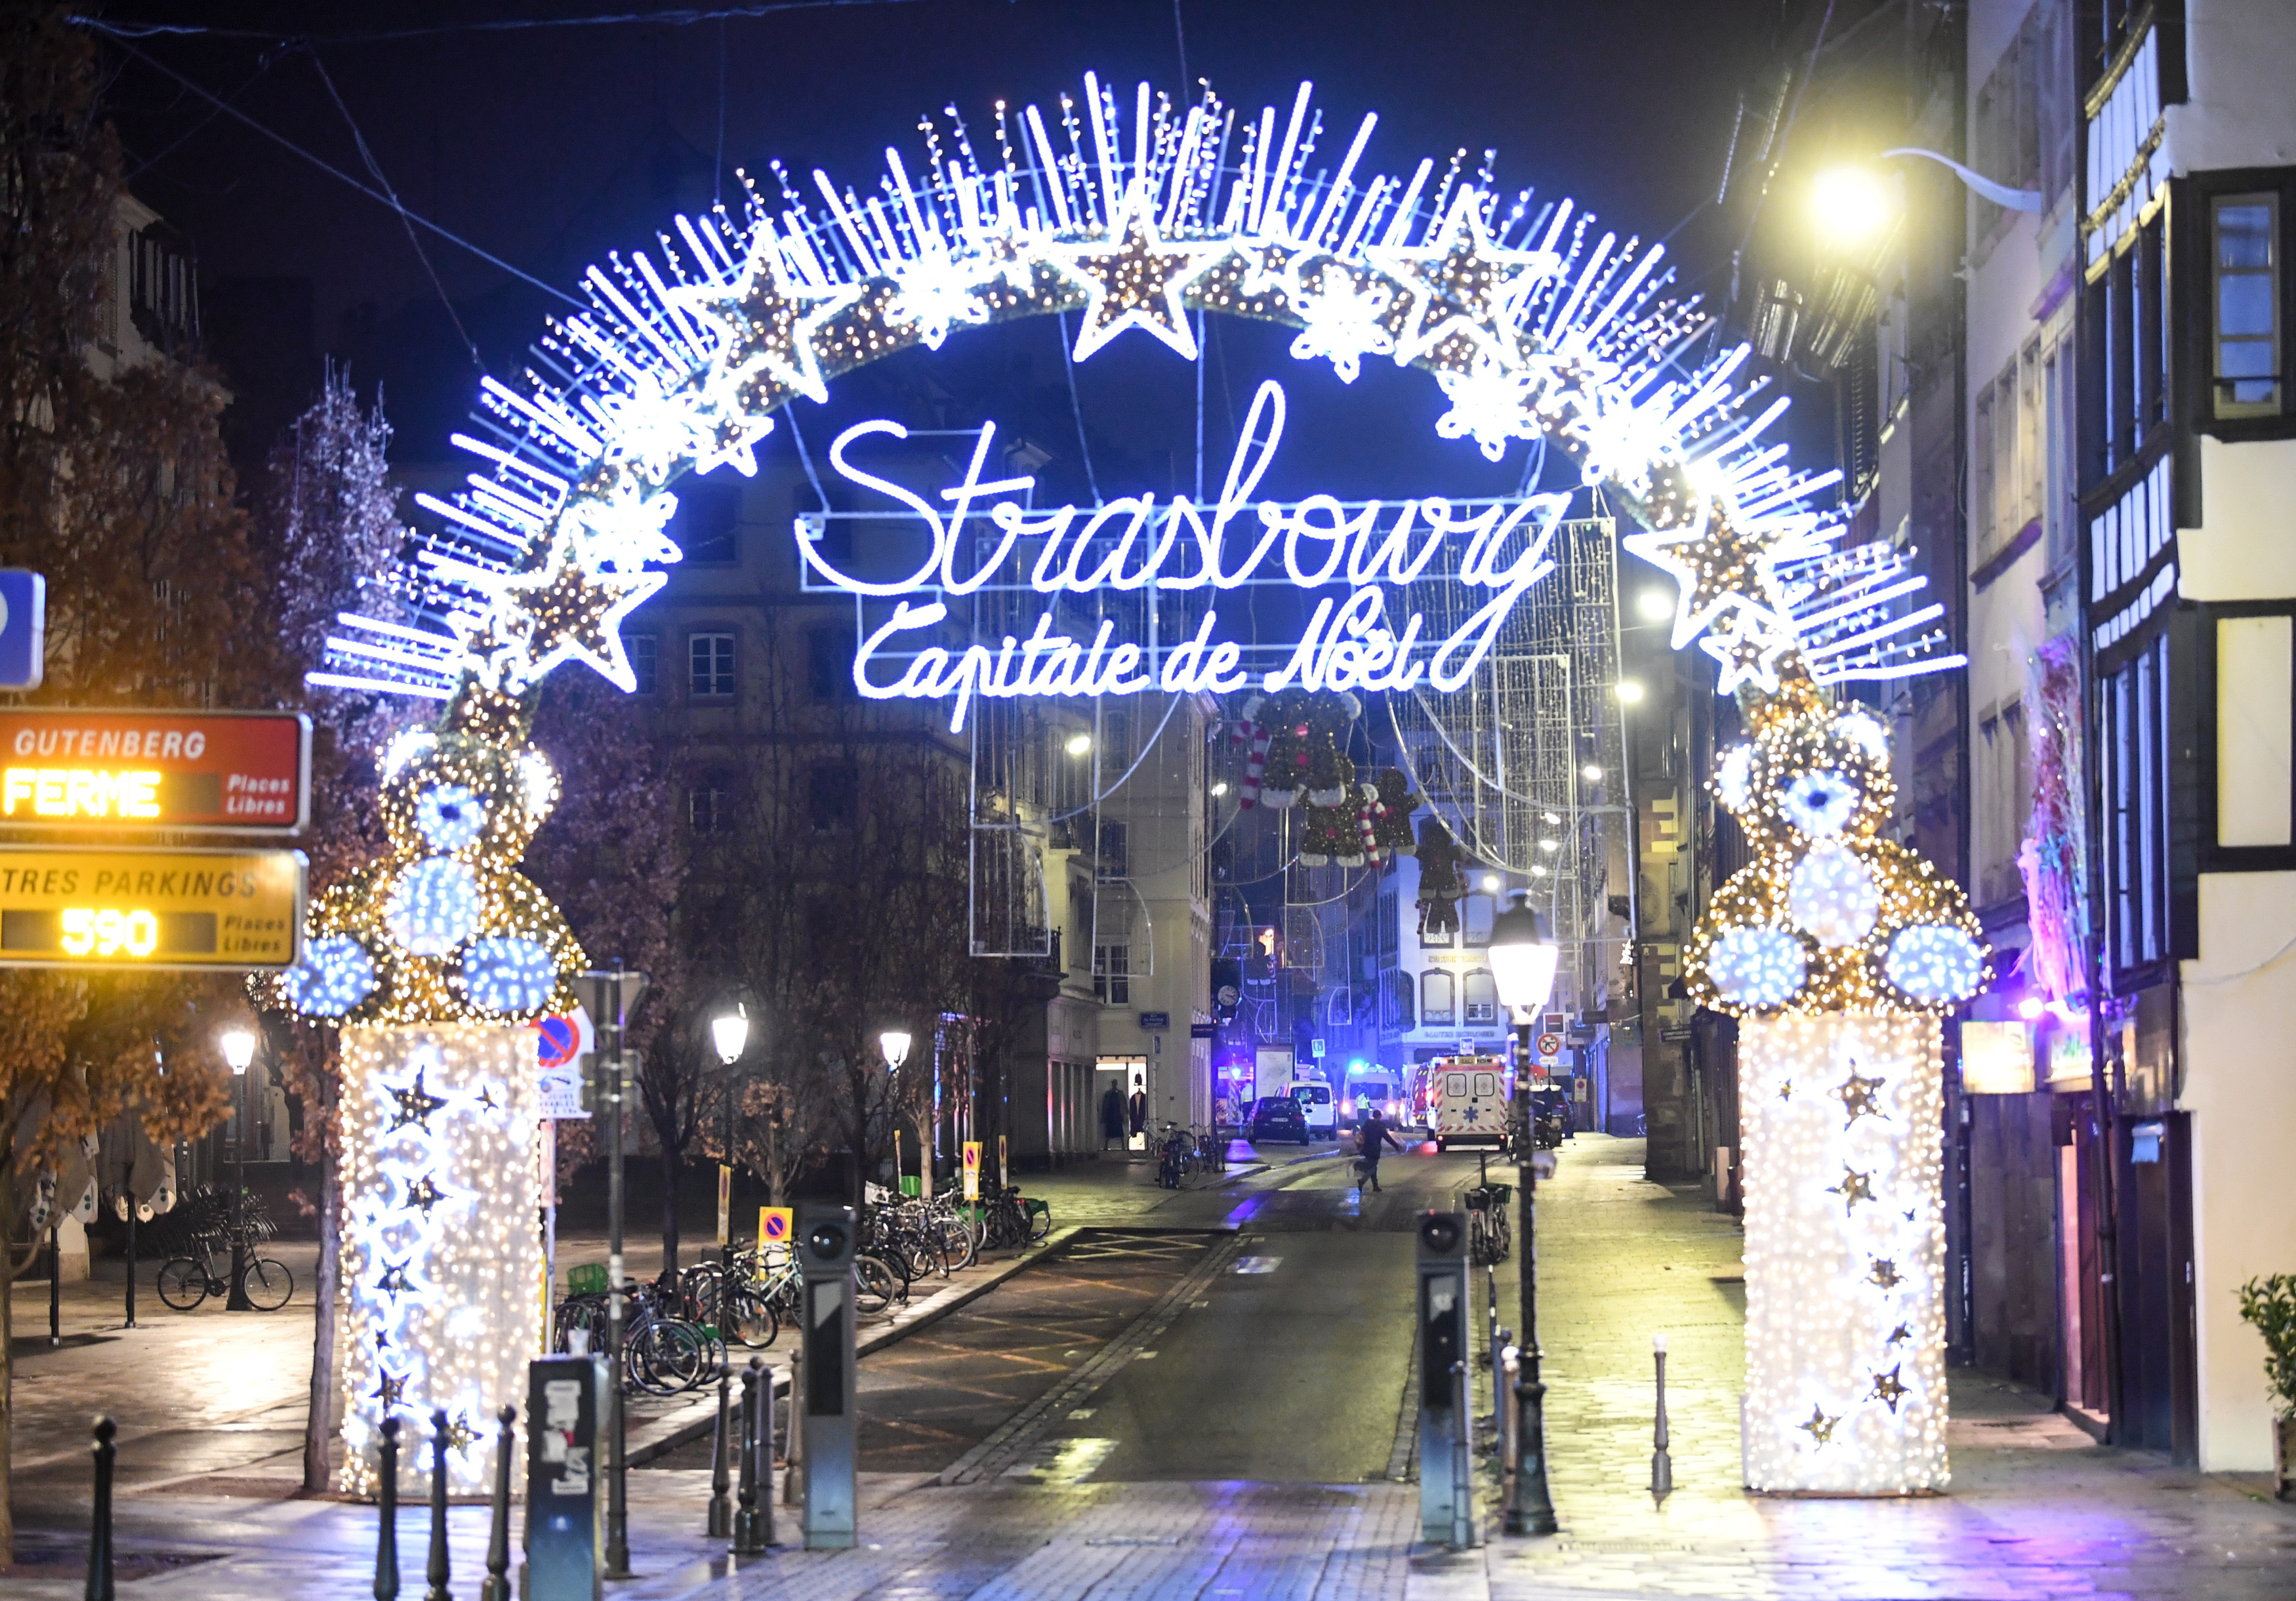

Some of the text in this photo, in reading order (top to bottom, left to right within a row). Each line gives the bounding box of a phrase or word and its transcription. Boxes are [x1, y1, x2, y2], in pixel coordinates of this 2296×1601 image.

[794, 378, 1574, 693] Strasbourg
[852, 584, 1426, 733] Capitale de Noël
[14, 728, 206, 759] GUTENBERG
[4, 768, 161, 817] FERME
[227, 773, 289, 793] Places
[226, 795, 285, 814] Libres
[94, 869, 258, 899] PARKINGS
[62, 908, 157, 956] 590
[224, 915, 285, 933] Places
[224, 936, 281, 953] Libres
